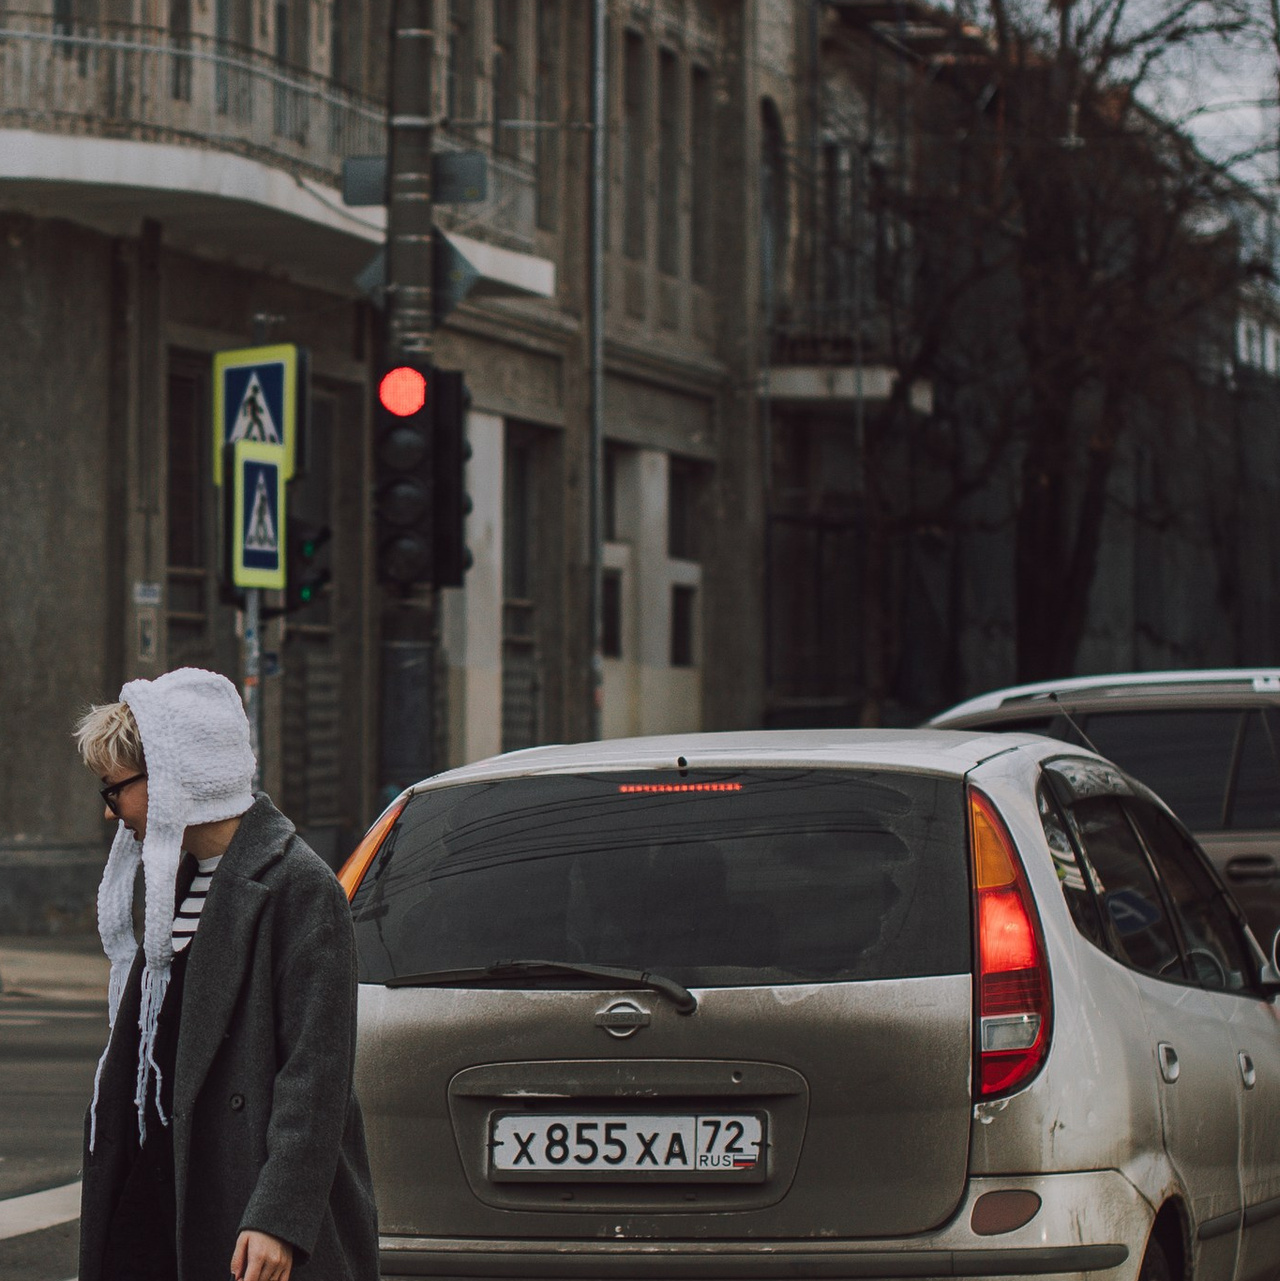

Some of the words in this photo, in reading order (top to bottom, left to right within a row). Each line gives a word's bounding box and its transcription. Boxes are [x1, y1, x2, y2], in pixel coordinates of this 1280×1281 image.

[600, 1014, 643, 1024] NISSAN
[702, 1120, 745, 1154] 72
[699, 1154, 732, 1168] RUS
